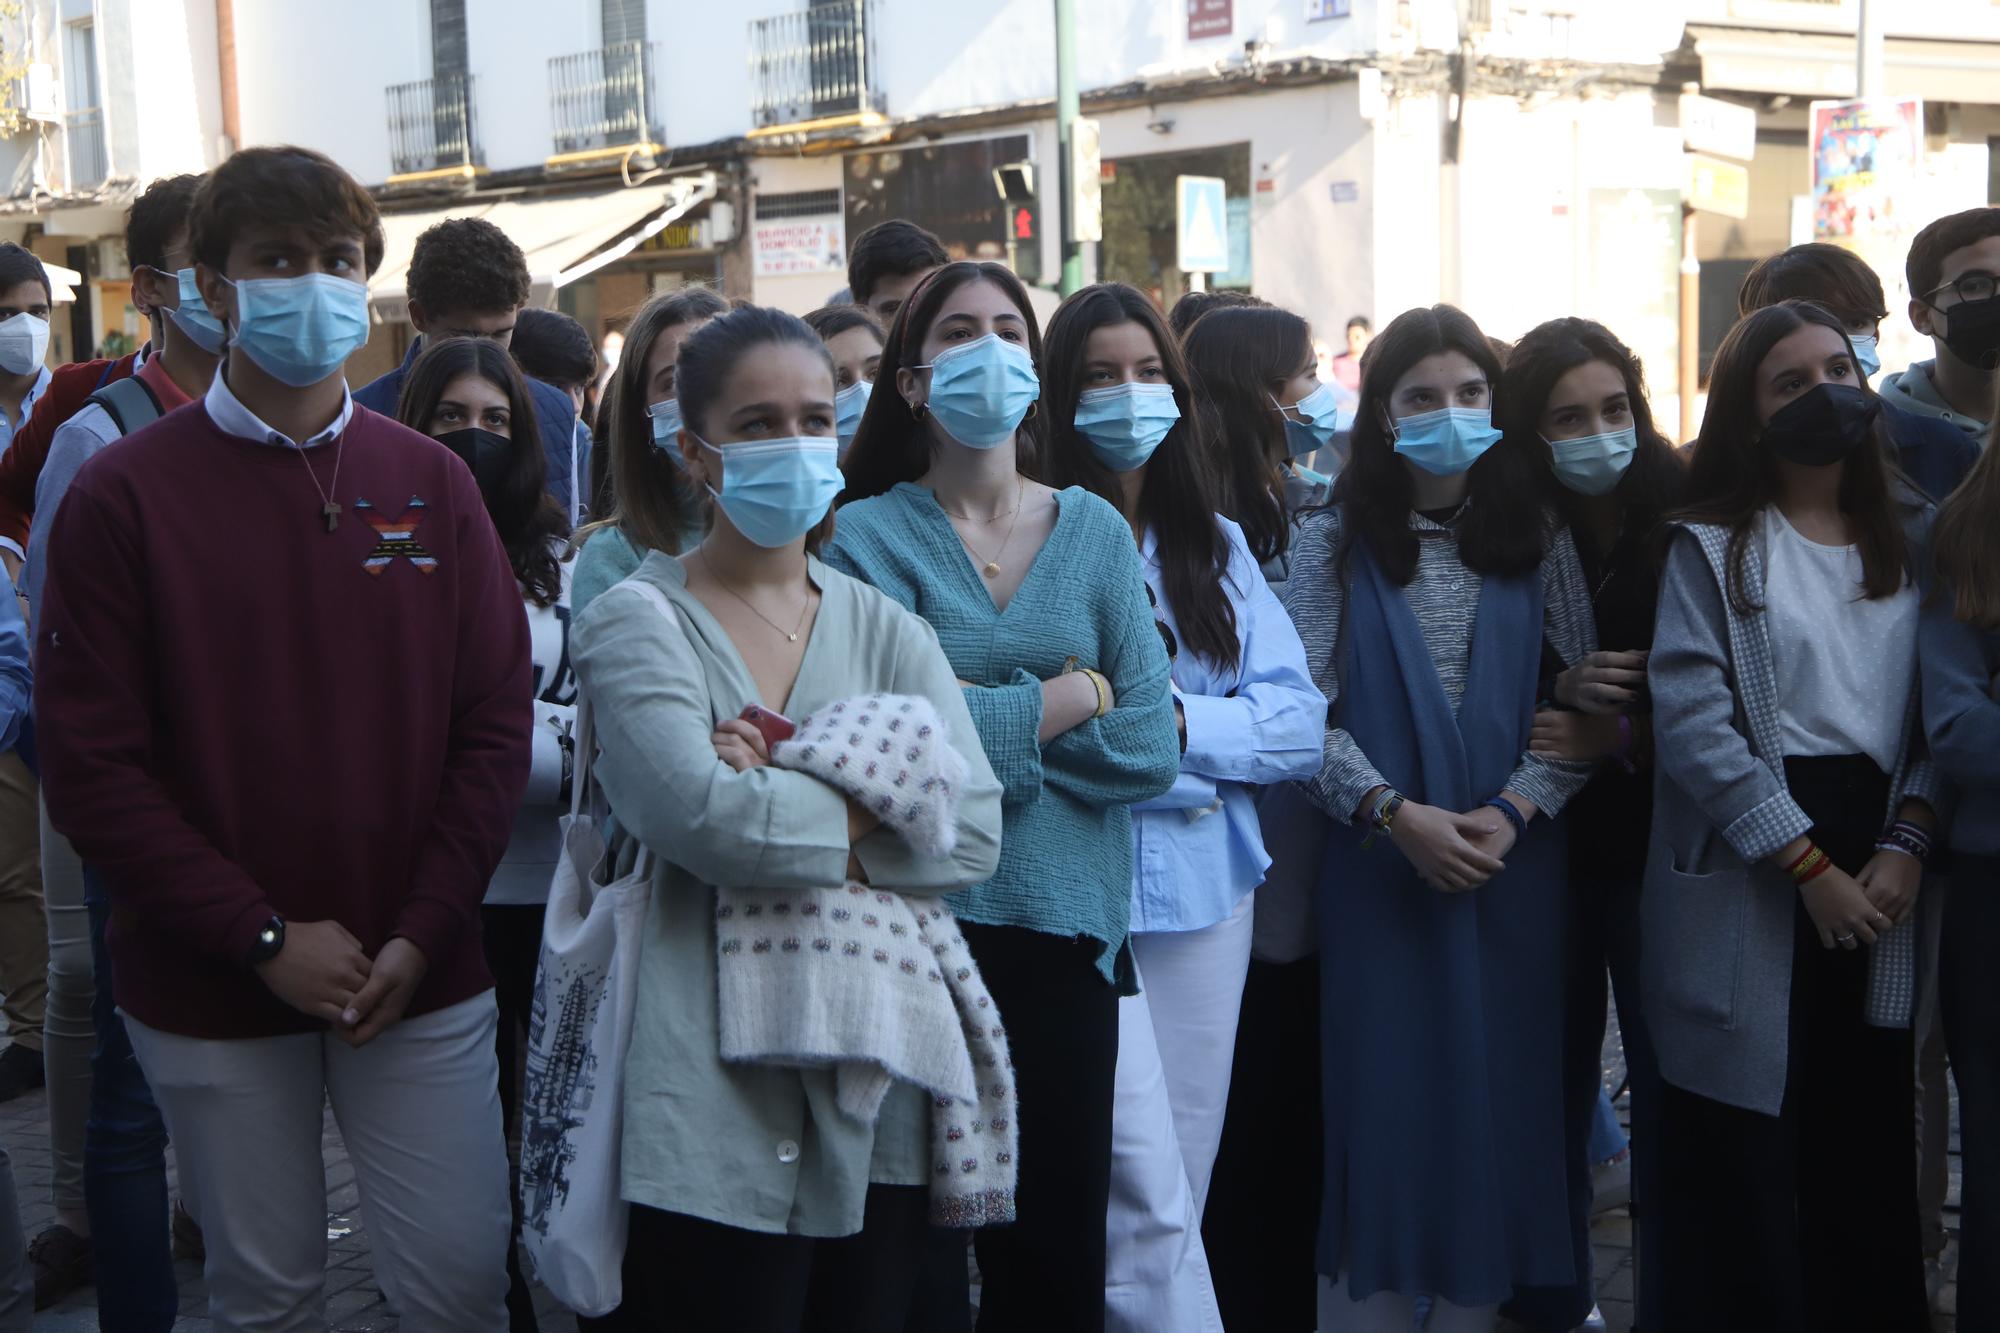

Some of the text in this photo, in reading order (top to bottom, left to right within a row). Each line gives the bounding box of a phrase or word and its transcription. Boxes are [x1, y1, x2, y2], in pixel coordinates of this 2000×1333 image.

[756, 225, 824, 239] SERVICIO A
[761, 237, 821, 250] DOMICILIO
